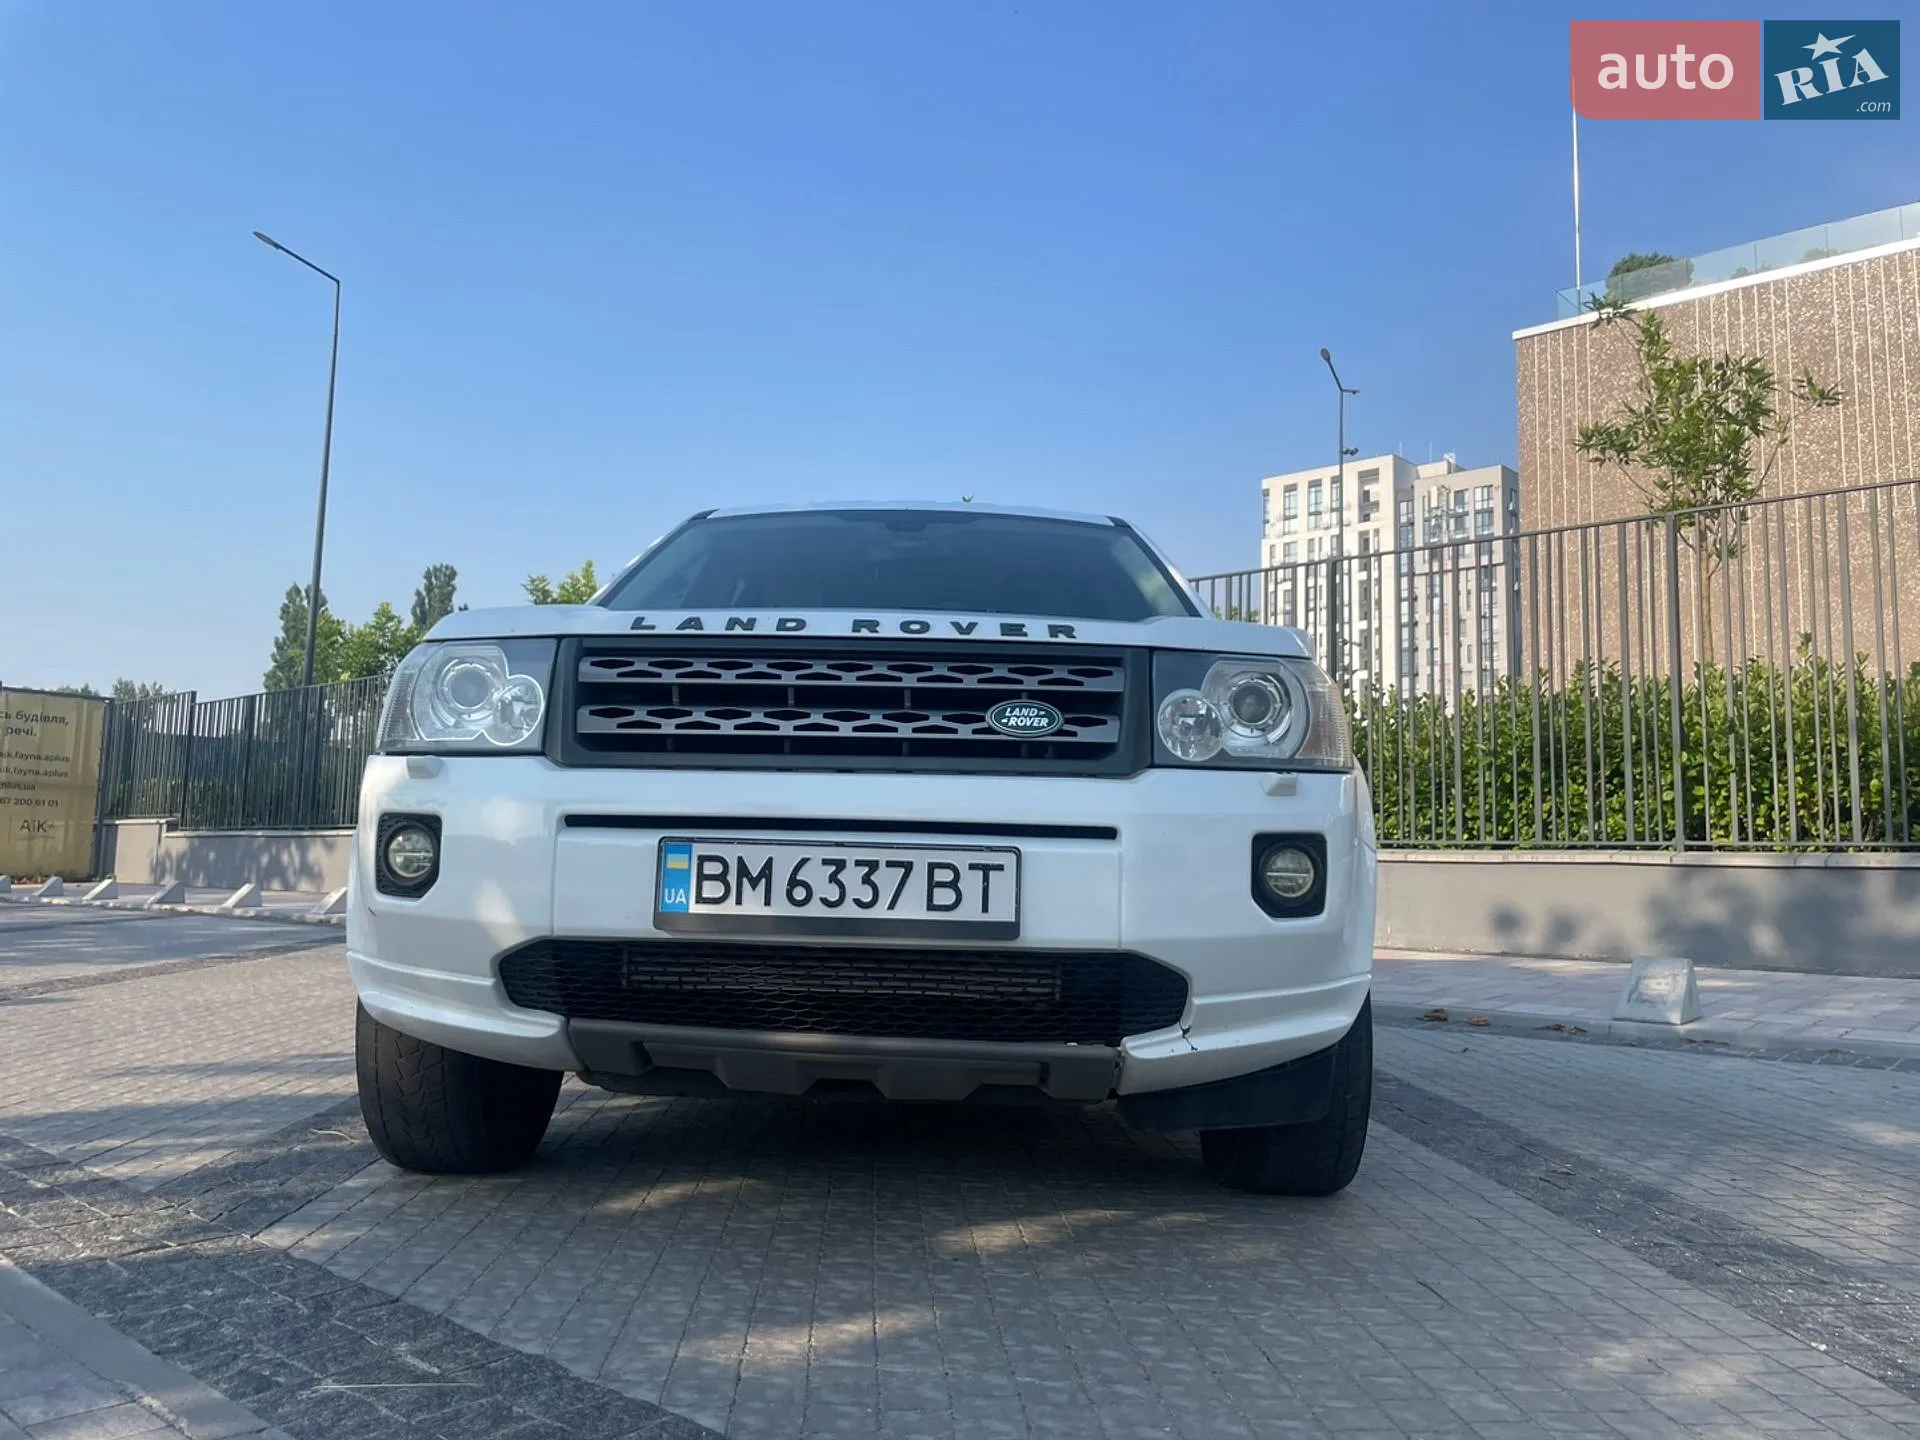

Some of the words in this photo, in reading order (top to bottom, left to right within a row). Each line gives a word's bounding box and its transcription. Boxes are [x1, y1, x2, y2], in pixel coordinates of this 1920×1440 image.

[630, 616, 807, 632] LAND
[851, 618, 1078, 640] ROVER
[16, 710, 69, 726] будівля,
[6, 726, 37, 737] речі.
[664, 888, 687, 904] UA
